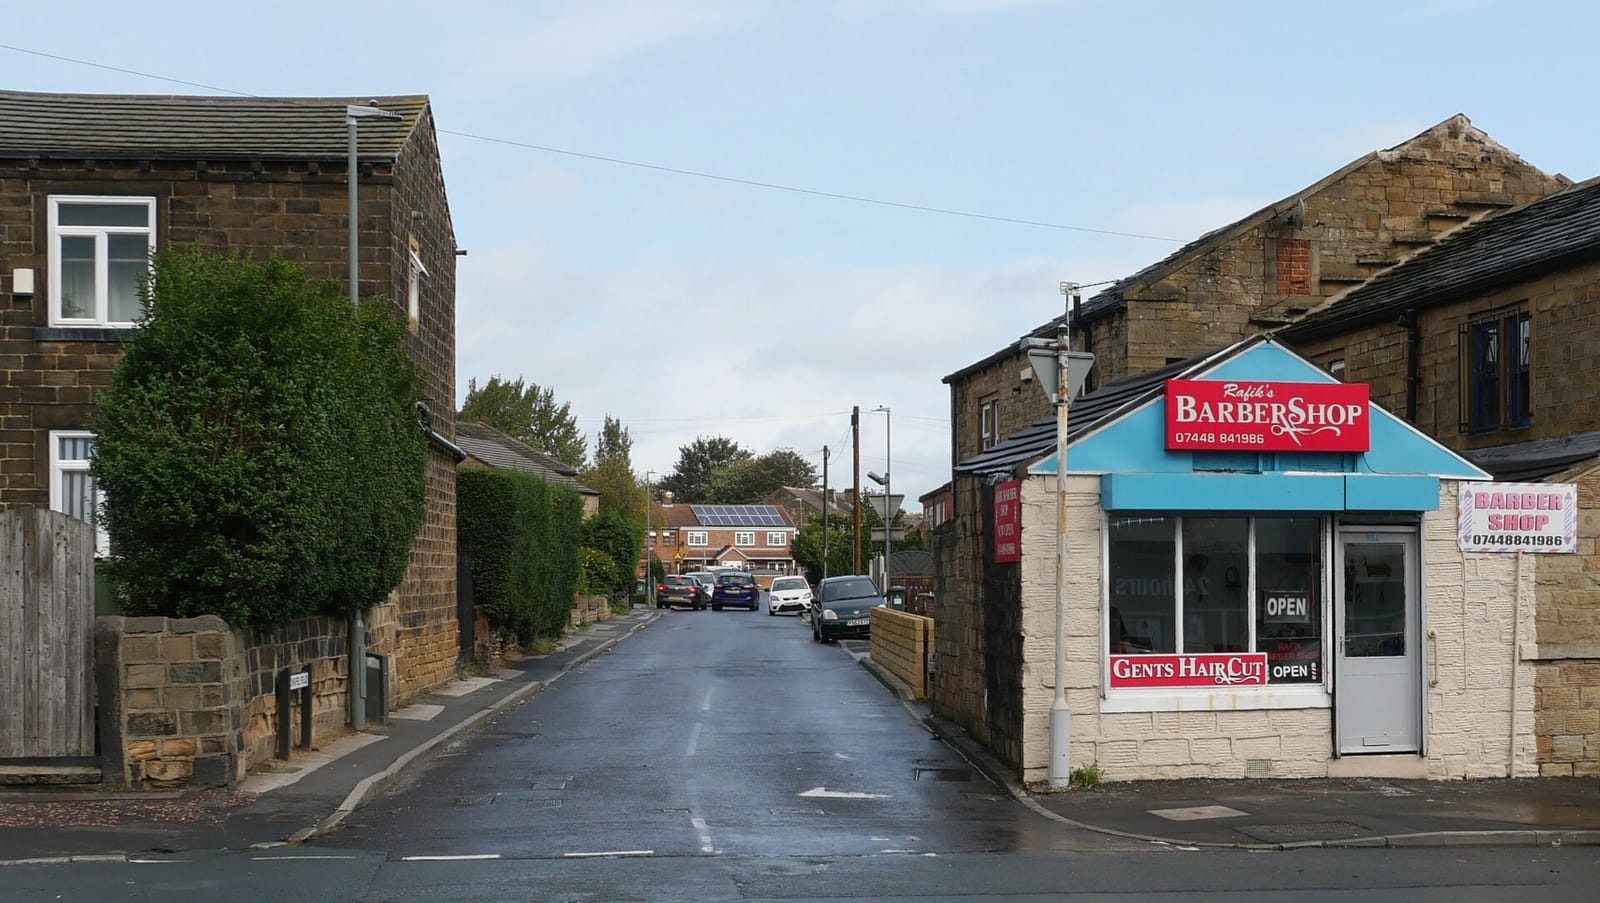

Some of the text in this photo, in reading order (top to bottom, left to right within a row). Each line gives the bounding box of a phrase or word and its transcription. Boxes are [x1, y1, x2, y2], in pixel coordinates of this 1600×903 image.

[1223, 383, 1275, 401] Rafik's
[1175, 432, 1265, 444] 07448 841986
[1474, 492, 1563, 511] BARBER
[1488, 513, 1550, 531] SHOP
[1473, 534, 1563, 546] 07448841986
[1267, 597, 1307, 616] OPEN
[1113, 657, 1264, 679] GENTS HAIRCUT
[1273, 665, 1308, 678] OPEN
